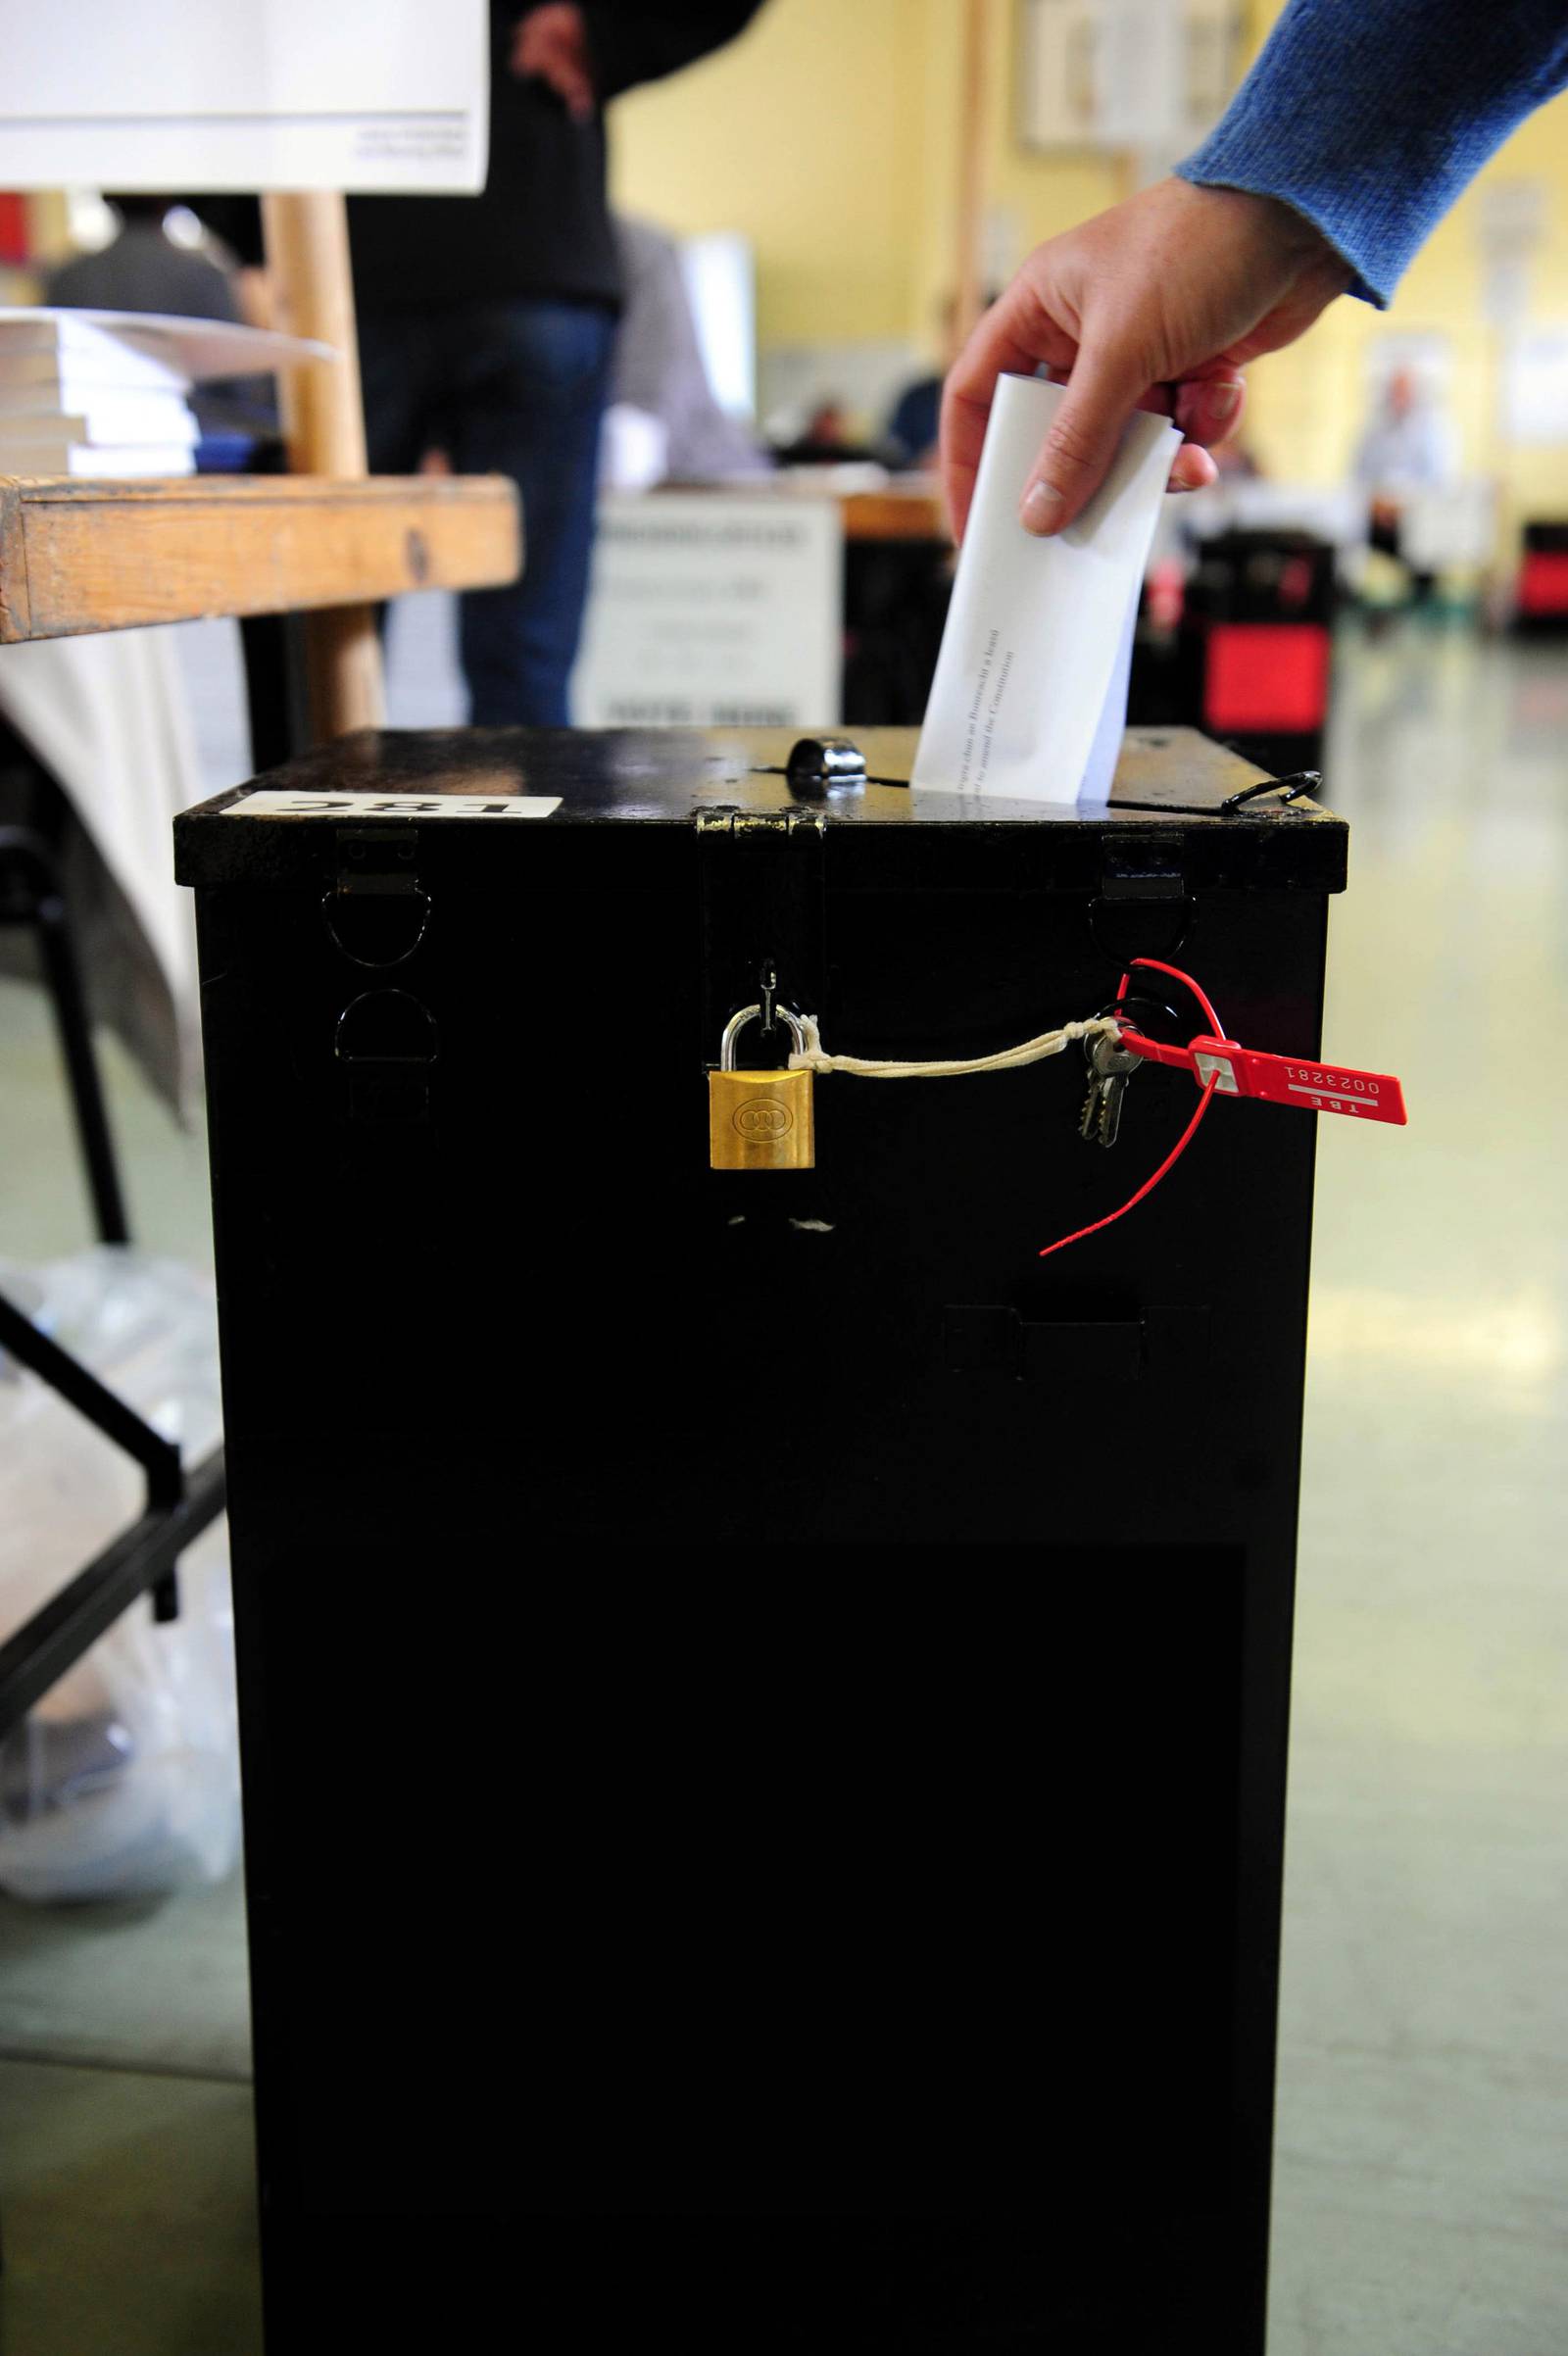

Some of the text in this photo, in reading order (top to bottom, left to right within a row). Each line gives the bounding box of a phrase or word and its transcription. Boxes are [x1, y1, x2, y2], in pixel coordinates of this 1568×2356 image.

[989, 651, 1013, 715] Constitution
[984, 716, 996, 733] the
[981, 734, 992, 769] amend
[274, 800, 523, 814] 281
[1284, 1065, 1380, 1095] 0023281
